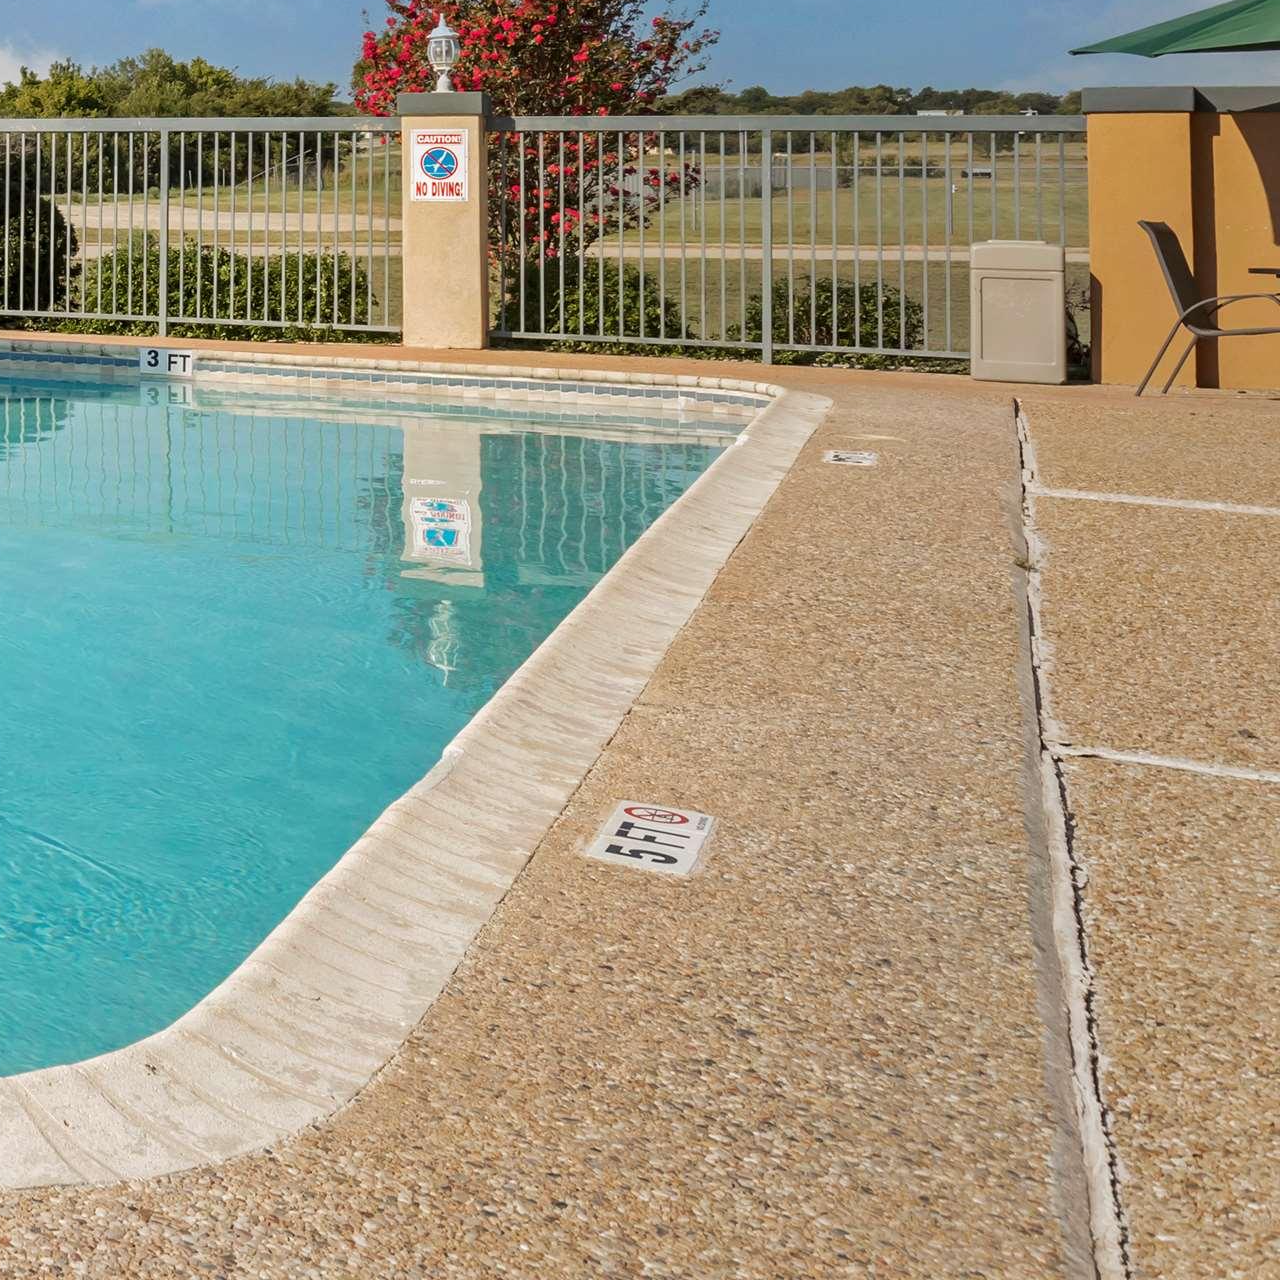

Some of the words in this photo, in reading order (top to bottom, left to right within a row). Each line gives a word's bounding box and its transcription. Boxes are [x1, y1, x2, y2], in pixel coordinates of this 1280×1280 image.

[417, 135, 461, 143] CAUTION!
[416, 182, 427, 196] NO
[432, 182, 463, 196] DIVING!
[147, 350, 159, 367] 3
[168, 354, 190, 372] FT
[614, 821, 690, 849] FT
[605, 844, 678, 864] 5
